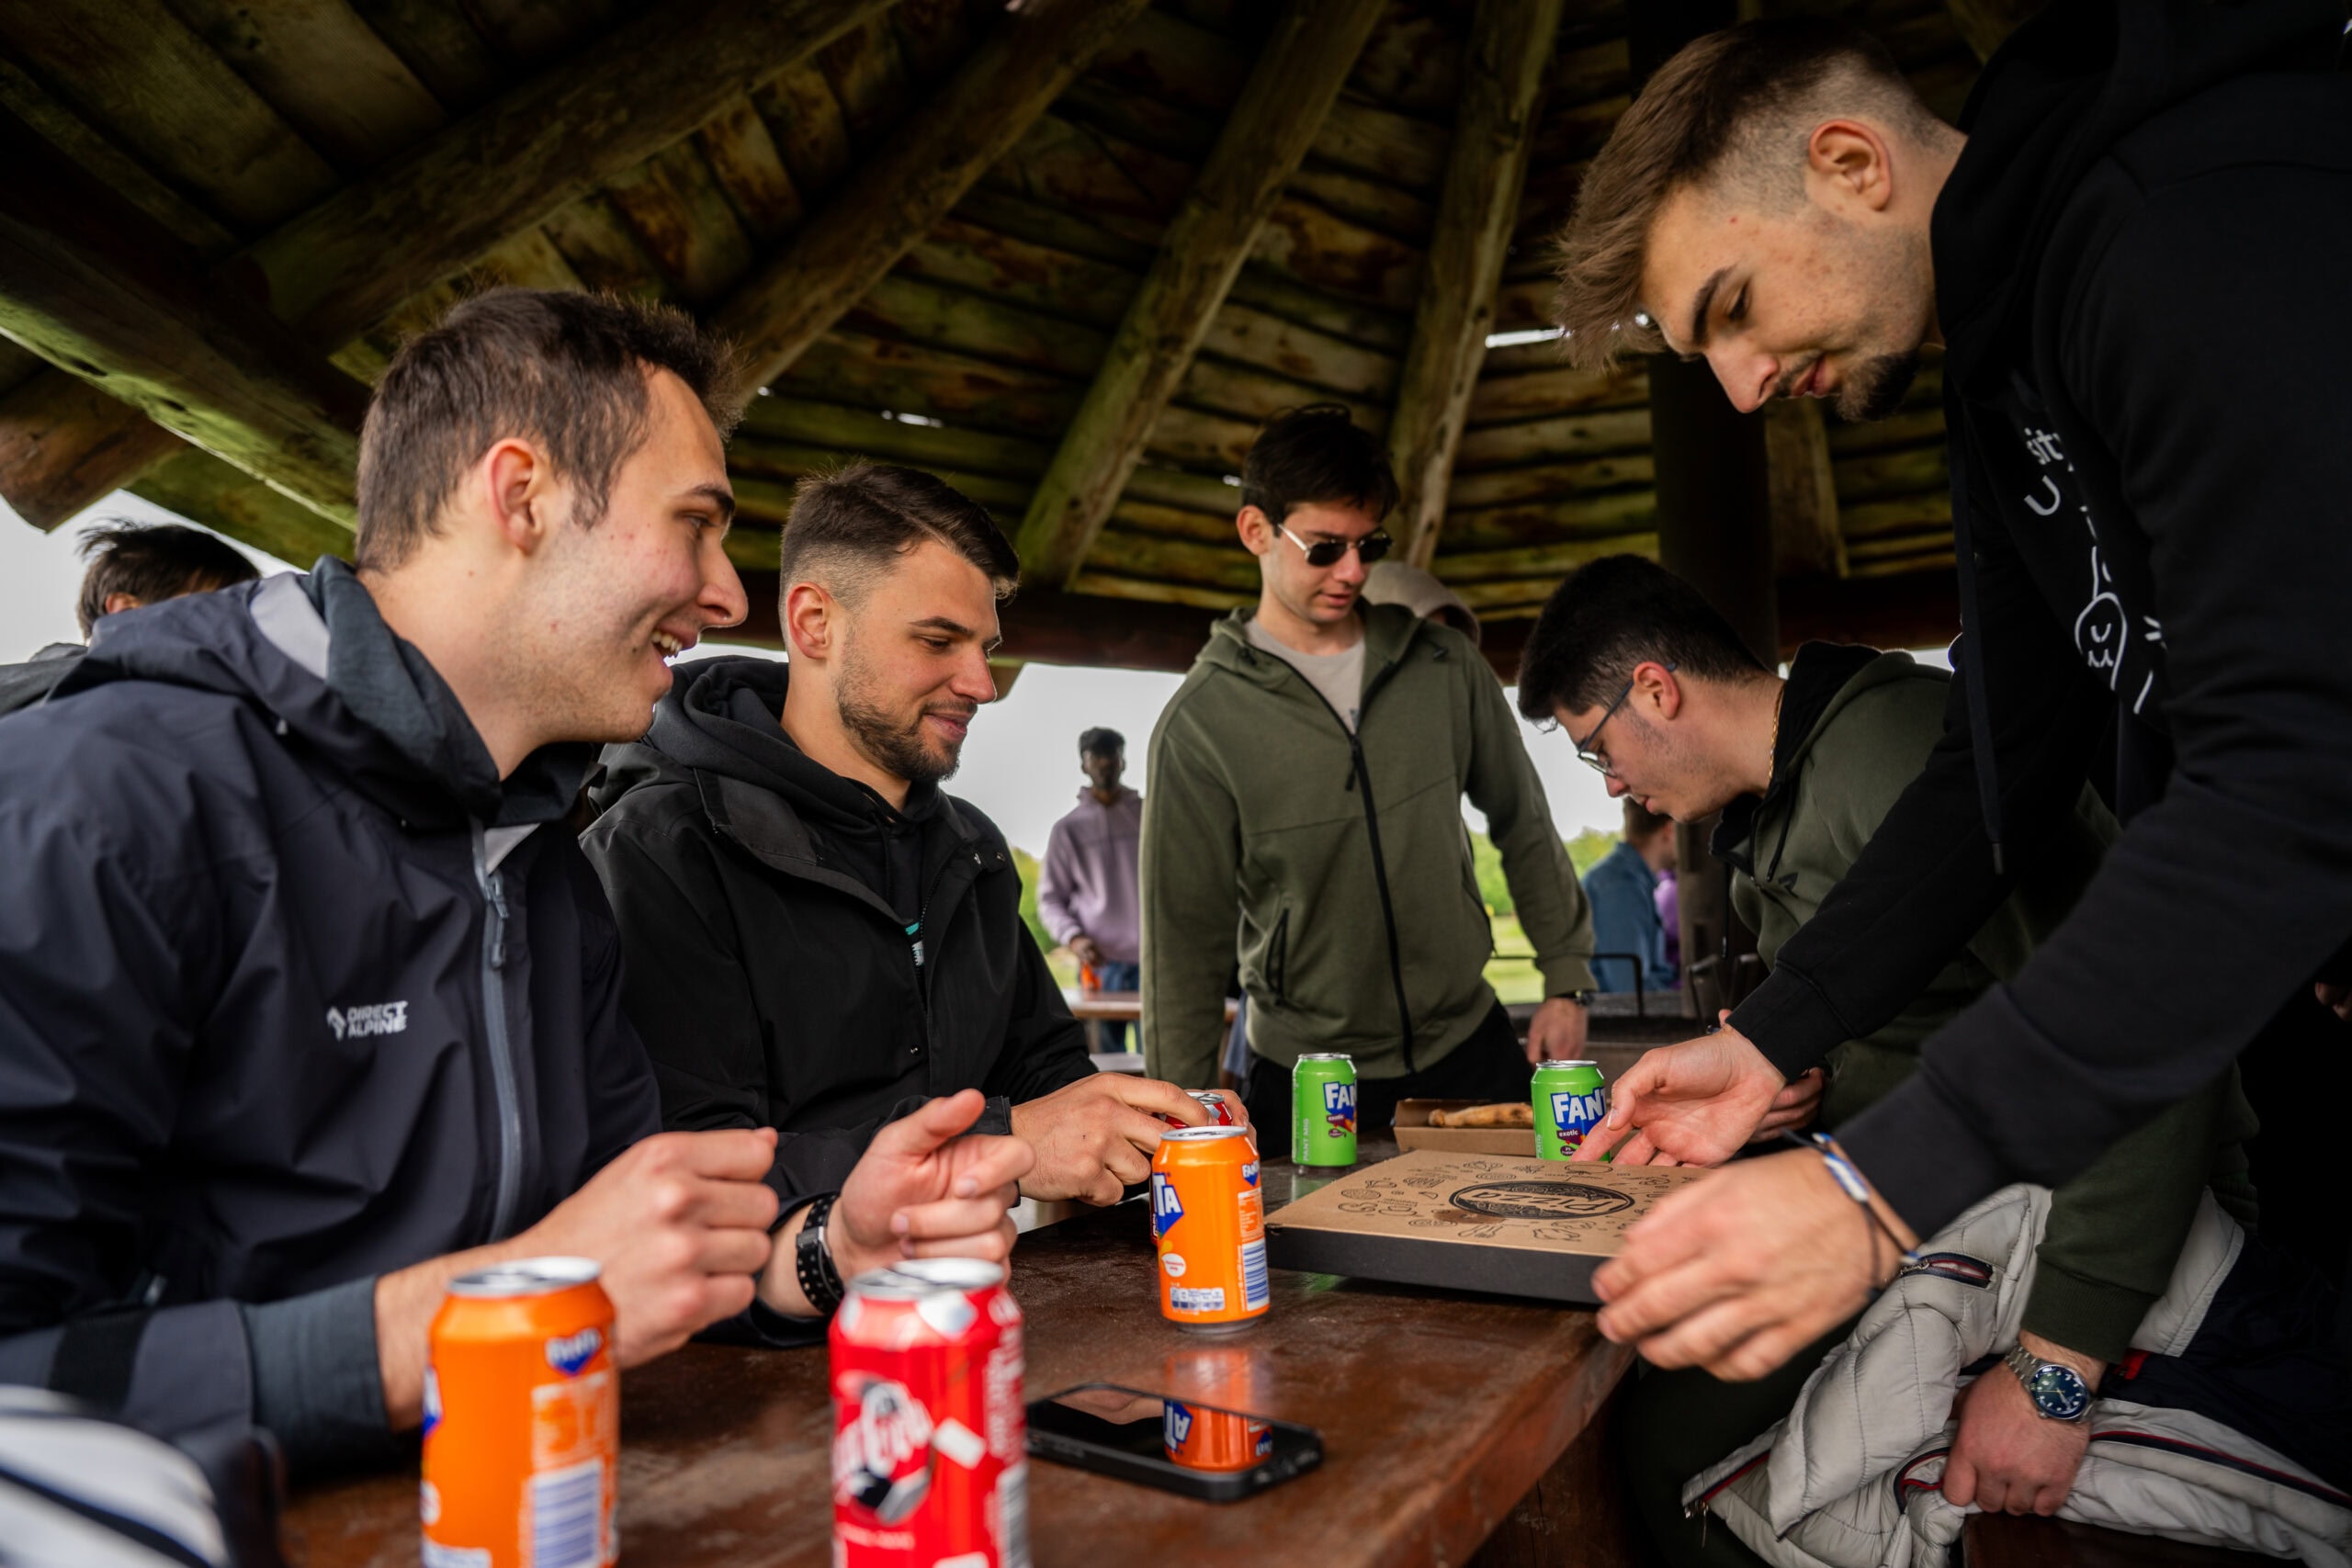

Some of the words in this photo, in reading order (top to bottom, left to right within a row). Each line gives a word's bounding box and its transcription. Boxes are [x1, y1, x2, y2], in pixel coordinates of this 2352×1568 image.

[347, 1000, 408, 1022] DIRECT
[347, 1015, 407, 1038] ALPINE
[1559, 1129, 1578, 1137] exotic
